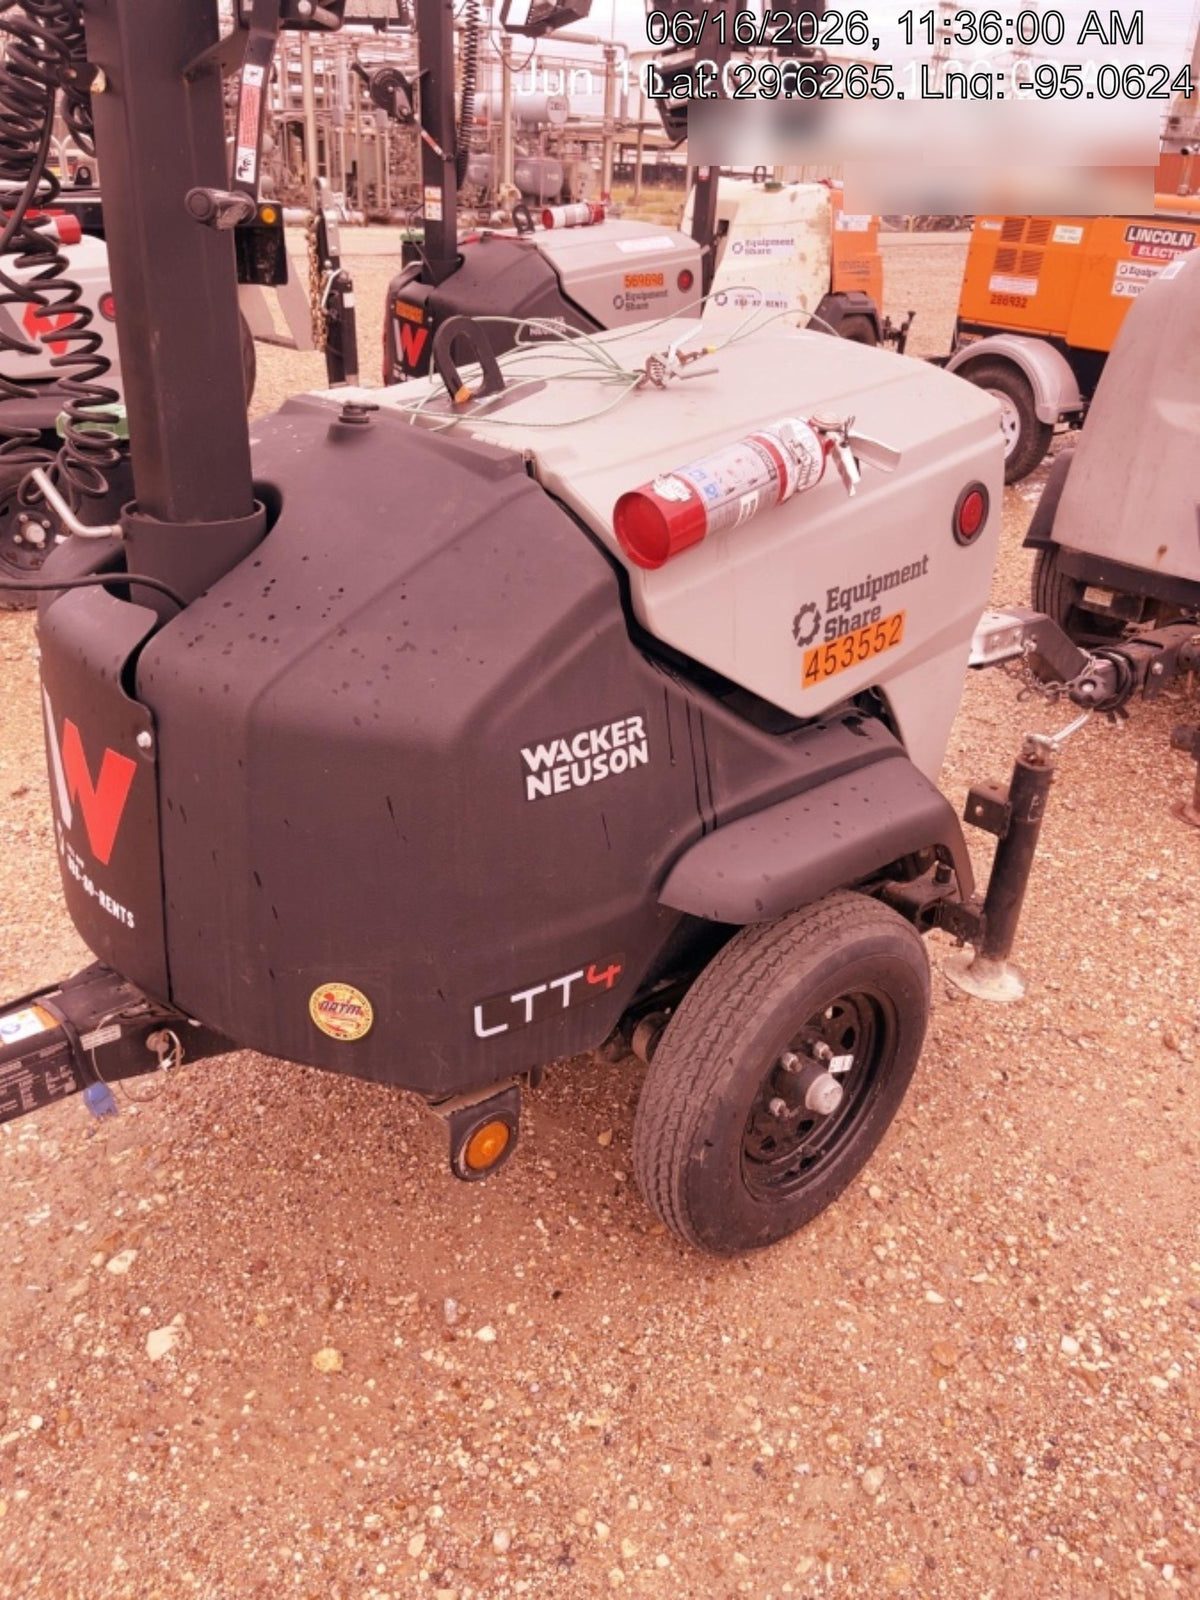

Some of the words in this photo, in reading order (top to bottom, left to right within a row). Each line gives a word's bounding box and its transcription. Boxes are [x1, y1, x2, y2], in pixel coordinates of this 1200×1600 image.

[1127, 226, 1194, 248] LINCOLN
[826, 554, 930, 614] Equipment
[805, 614, 904, 682] 453552
[824, 605, 881, 643] Share
[520, 716, 647, 772] WACKER
[526, 740, 649, 801] NEUSON
